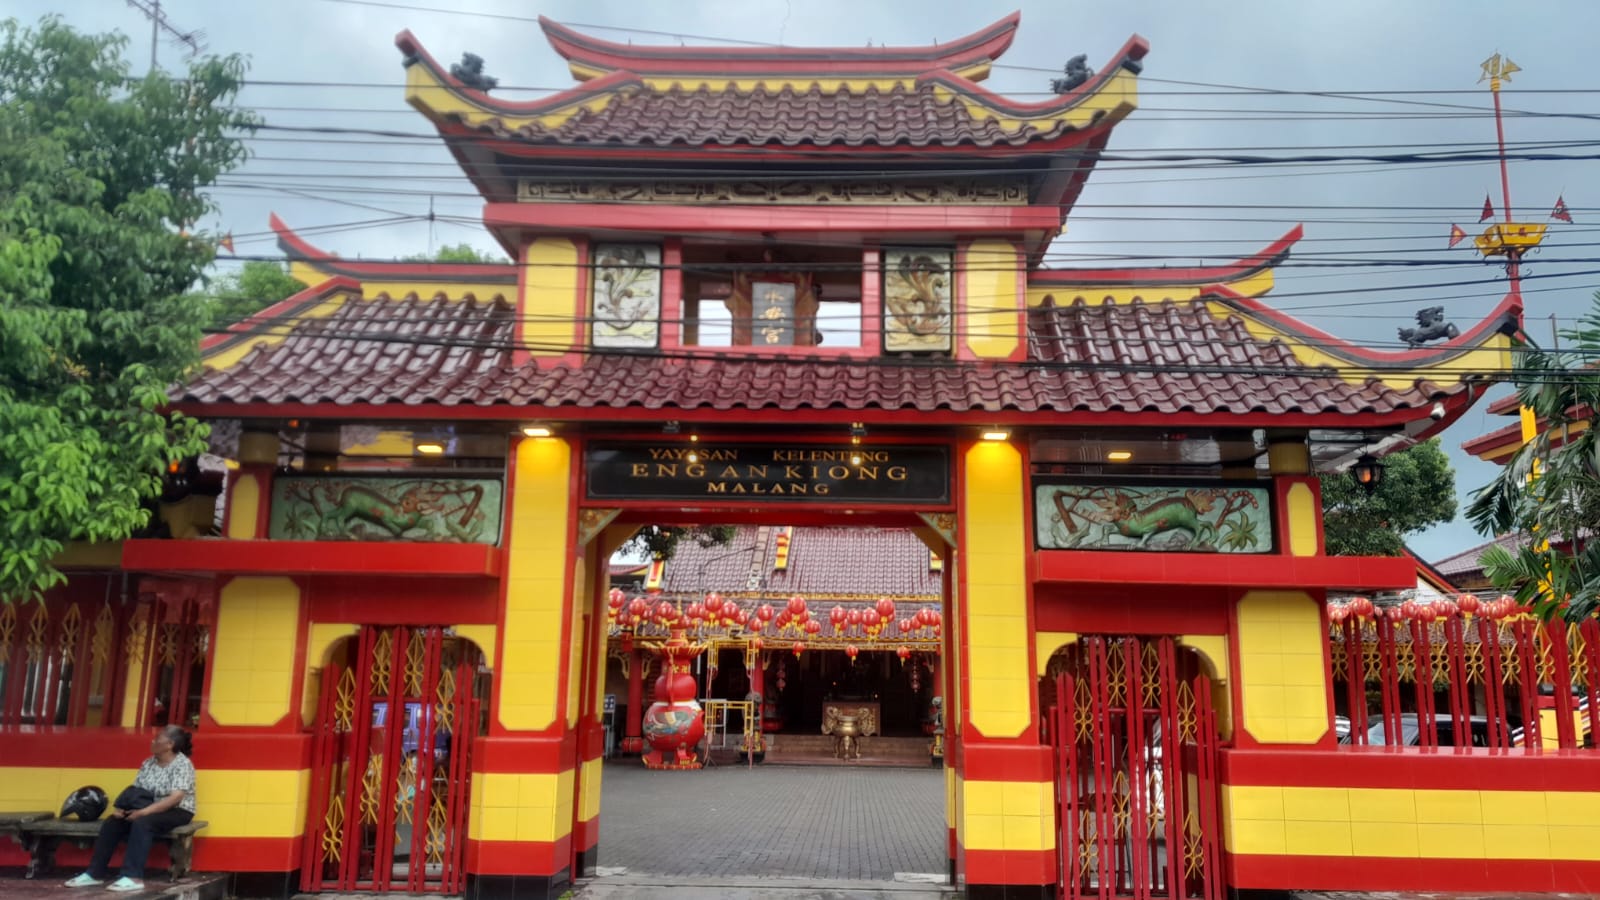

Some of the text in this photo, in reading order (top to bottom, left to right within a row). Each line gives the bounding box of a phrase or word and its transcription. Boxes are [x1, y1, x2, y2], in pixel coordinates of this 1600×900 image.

[632, 463, 908, 481] ENG AN KIONG
[708, 482, 830, 495] MALANG
